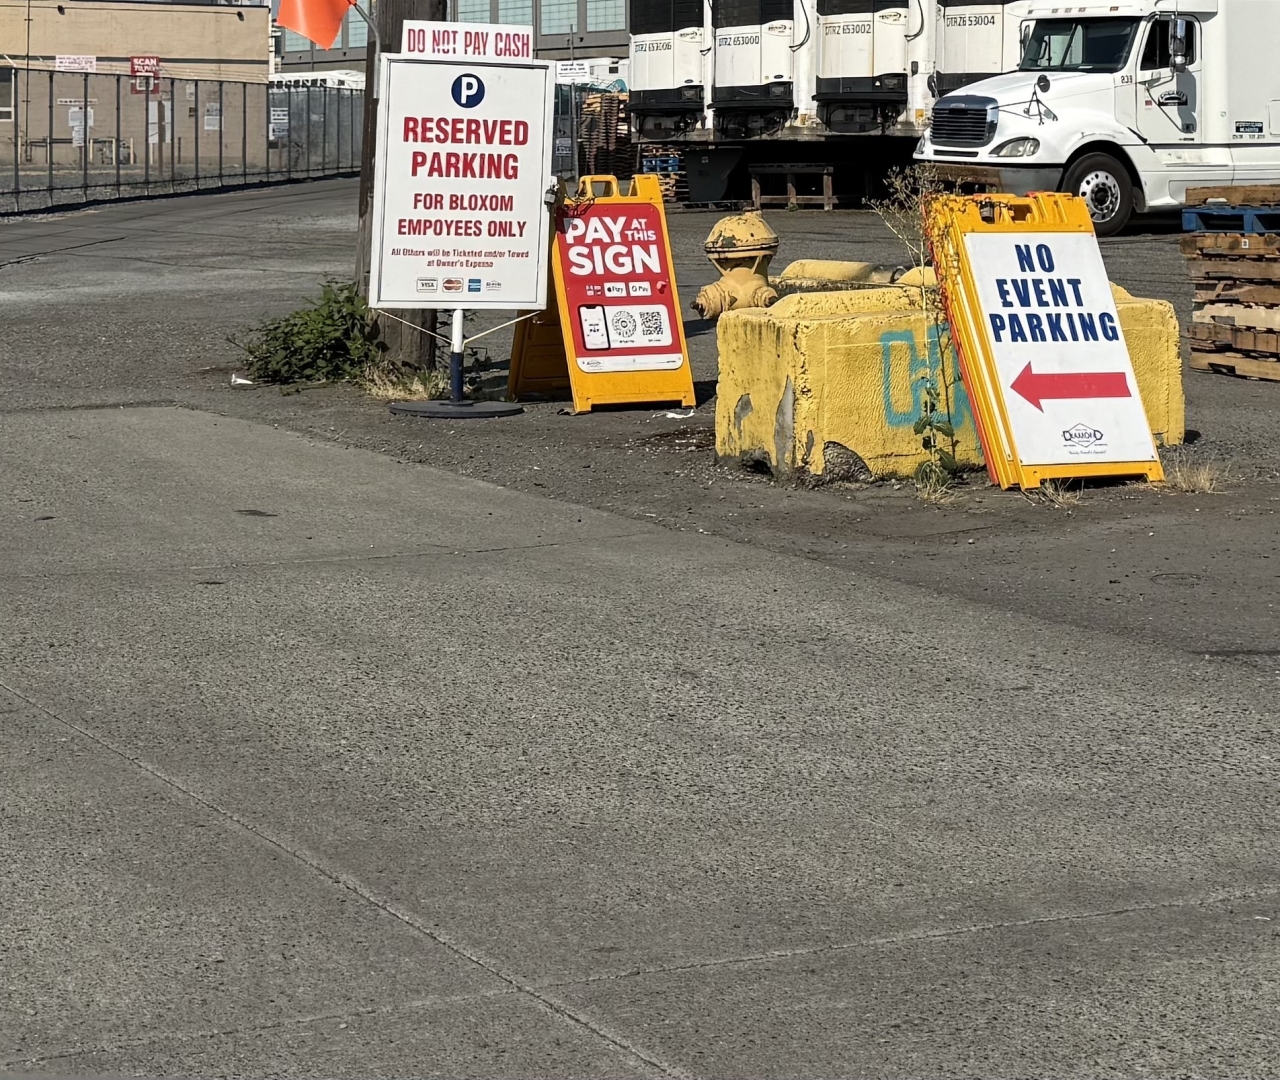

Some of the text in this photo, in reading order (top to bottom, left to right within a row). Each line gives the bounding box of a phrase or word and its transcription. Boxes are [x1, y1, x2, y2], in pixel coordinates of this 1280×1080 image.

[408, 28, 530, 57] DO NOT PAY CASH
[733, 36, 759, 46] 653000
[842, 24, 871, 34] 653002
[403, 117, 529, 146] RESERVED
[411, 151, 518, 179] PARKING
[413, 193, 513, 211] FOR BLOXOM
[398, 219, 527, 238] EMPOYEES ONLY
[565, 216, 647, 244] PAY AT
[624, 230, 656, 241] THIS
[453, 249, 482, 257] Ticketed
[484, 250, 506, 258] and/or
[568, 244, 661, 276] SIGN
[1014, 244, 1055, 272] NO
[996, 278, 1084, 308] EVENT
[988, 312, 1119, 343] PARKING
